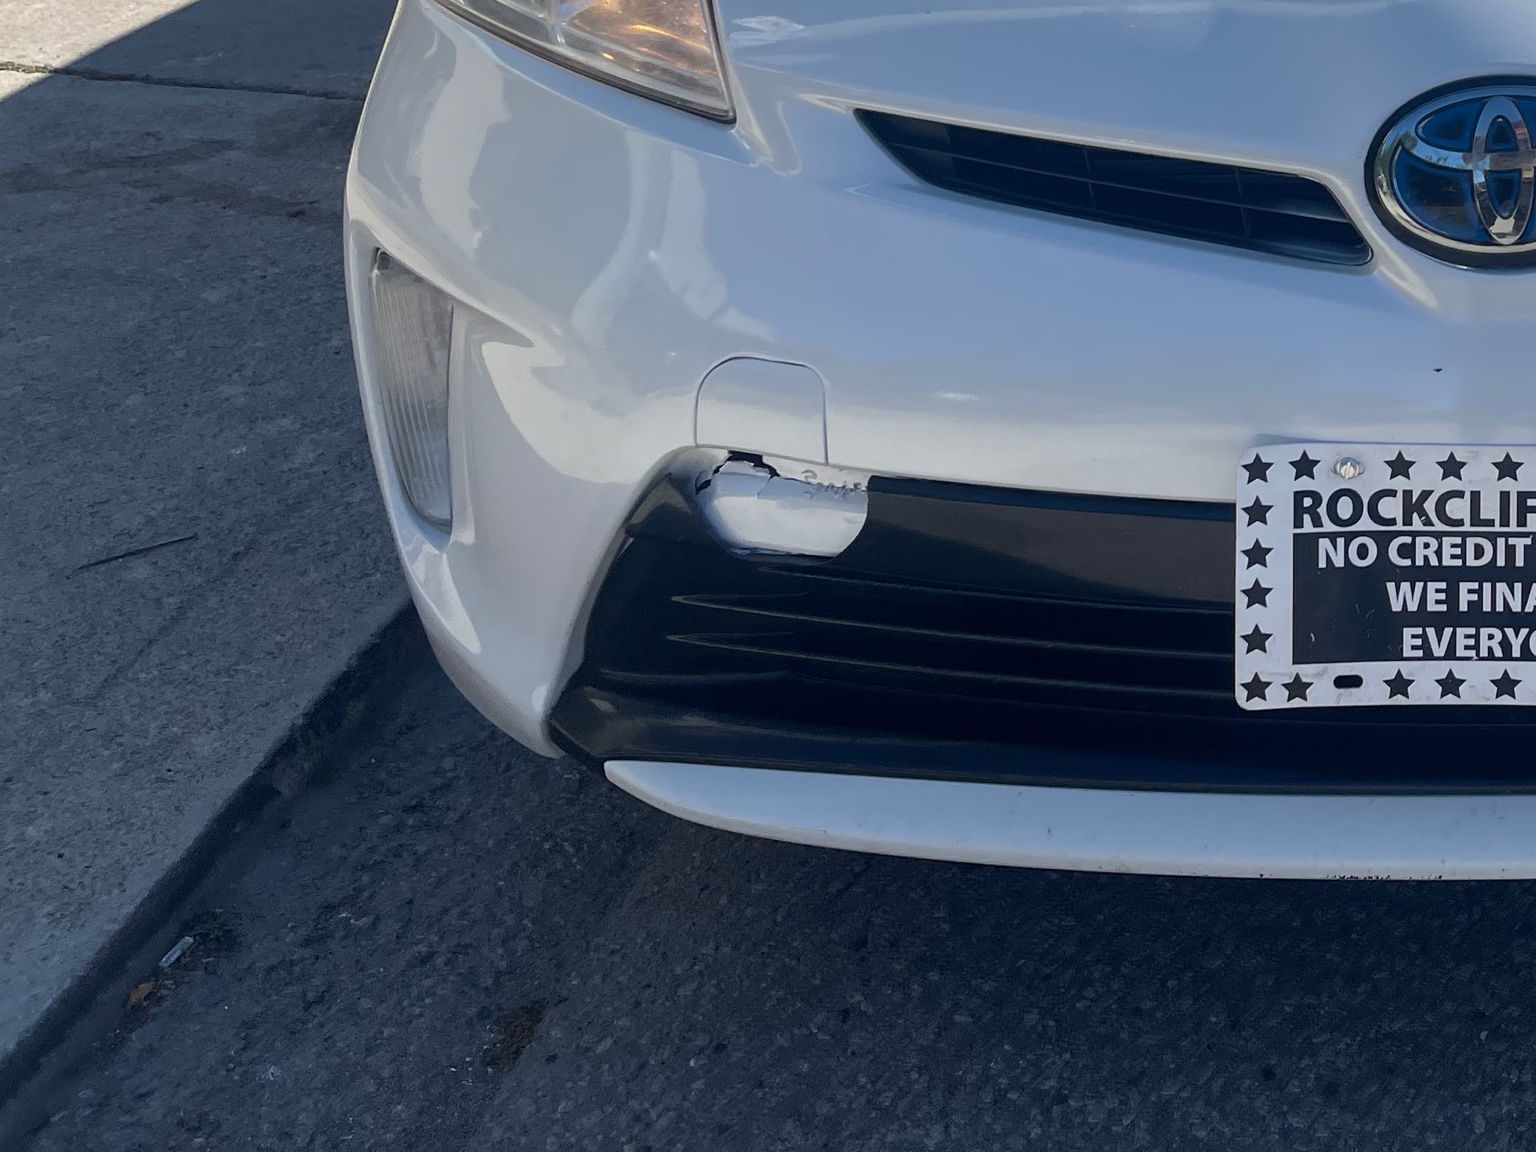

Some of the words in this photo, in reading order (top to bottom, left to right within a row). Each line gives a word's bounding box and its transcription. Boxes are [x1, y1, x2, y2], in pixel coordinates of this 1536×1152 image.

[1317, 536, 1378, 569] NO
[1387, 536, 1532, 570] CREDIT
[1386, 581, 1448, 612] WE
